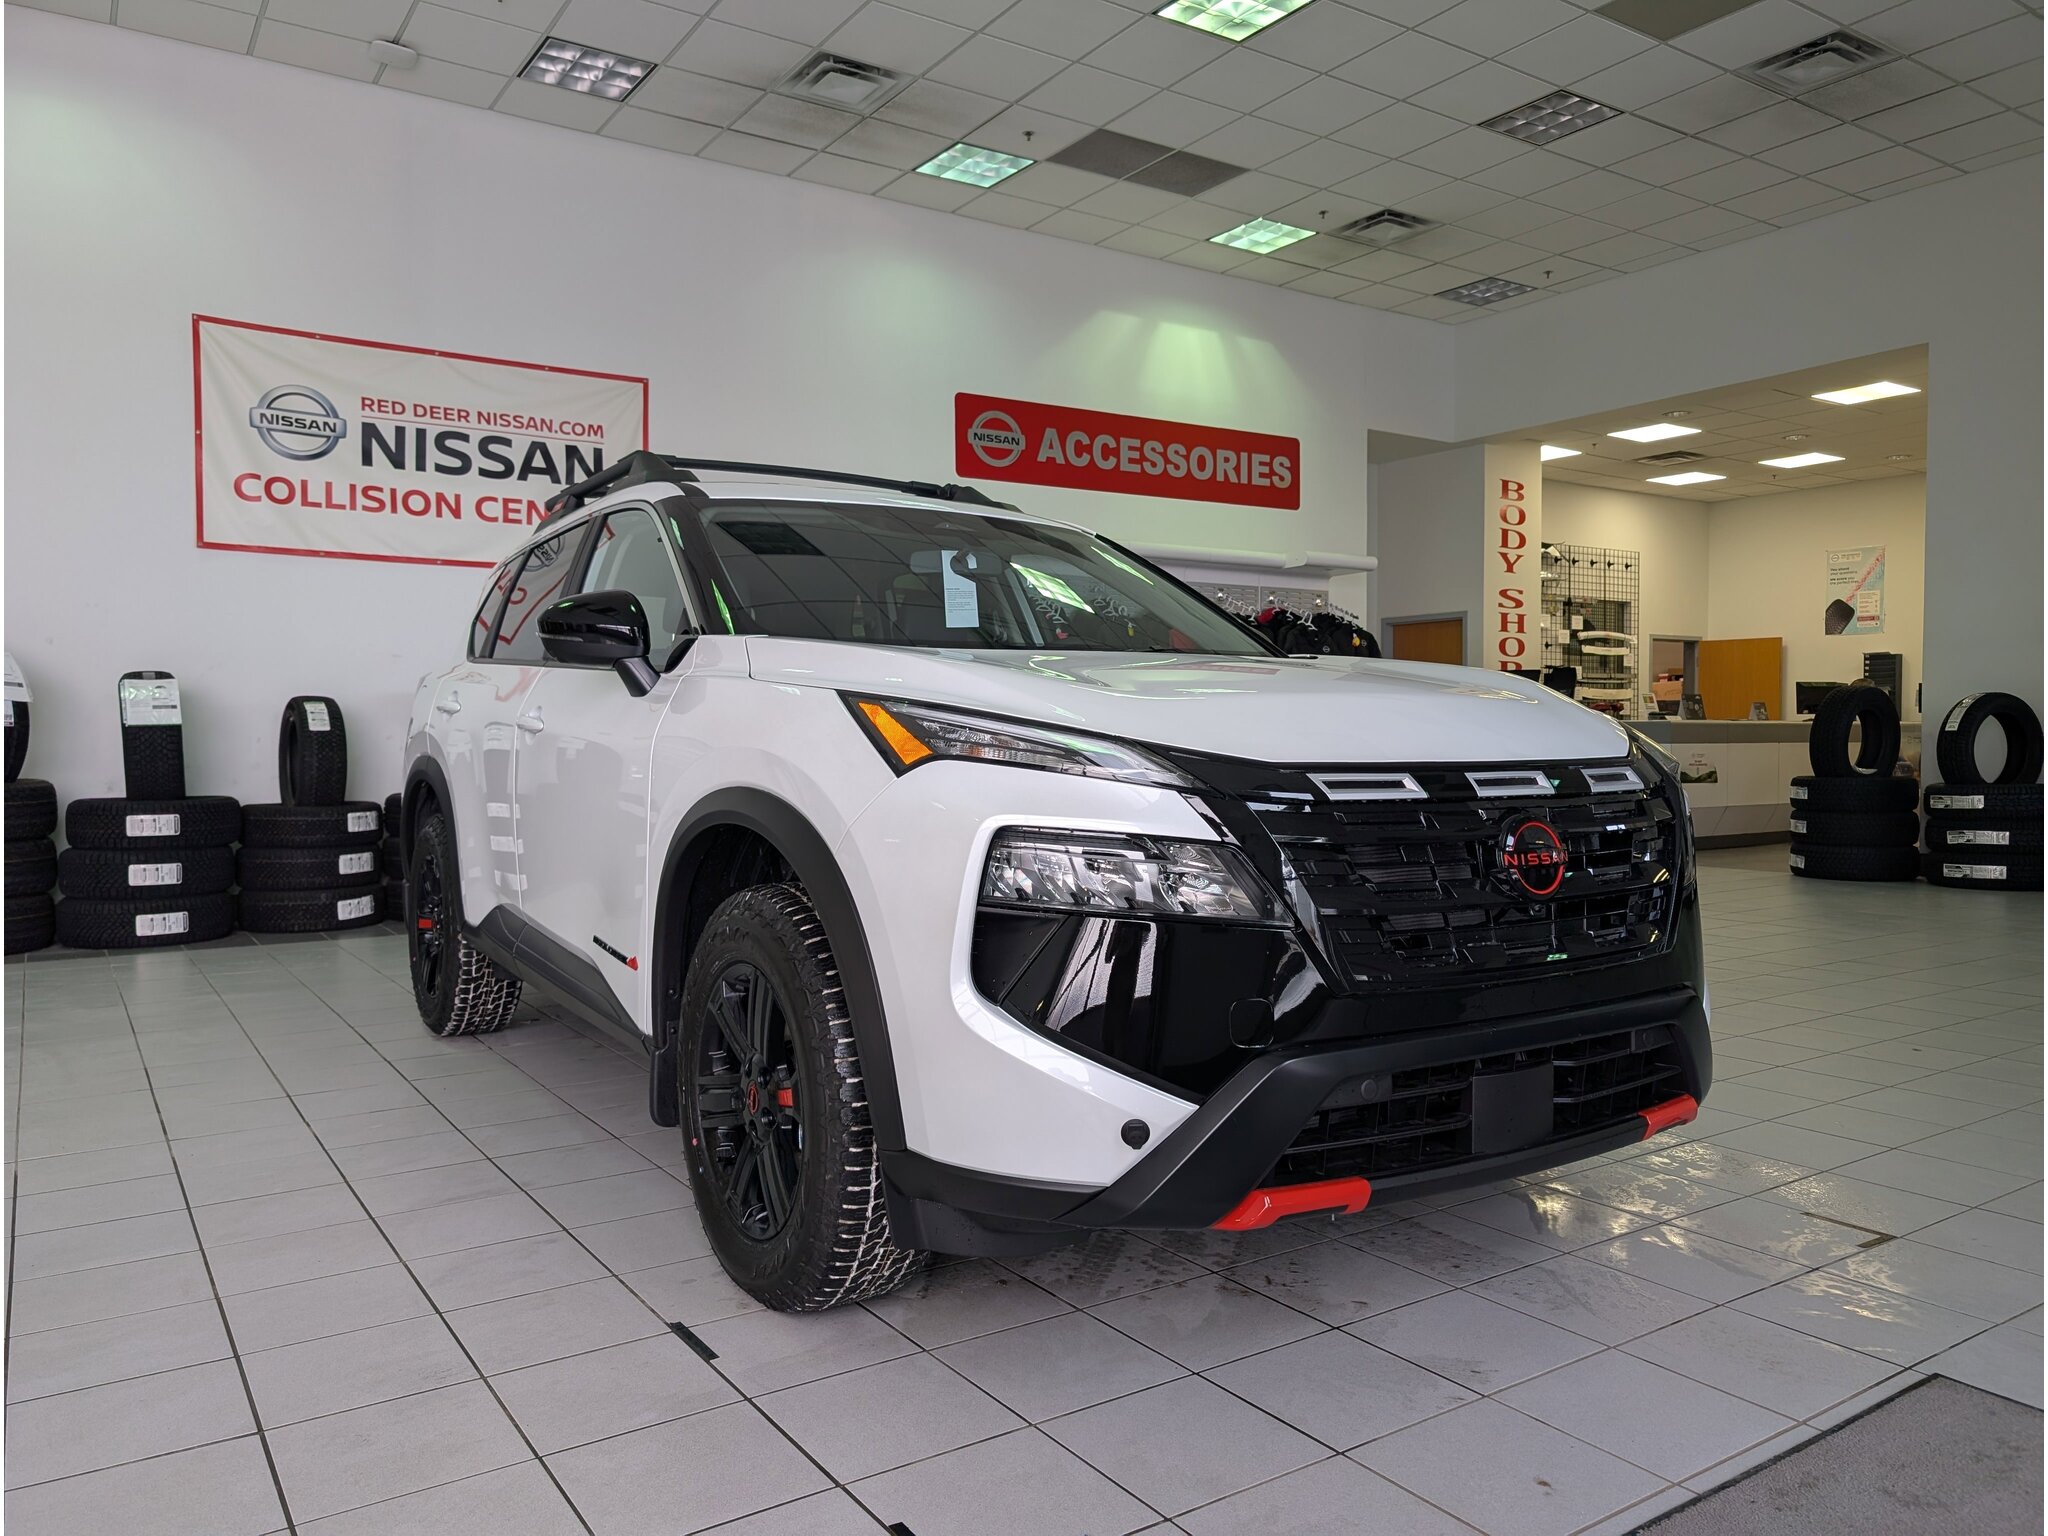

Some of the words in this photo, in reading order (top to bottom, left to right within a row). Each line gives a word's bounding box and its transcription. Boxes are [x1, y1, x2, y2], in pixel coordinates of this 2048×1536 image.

[259, 411, 338, 434] NISSAN
[360, 396, 406, 416] RED
[413, 402, 471, 424] DEER
[476, 410, 605, 439] NISSAN.COM
[972, 431, 1021, 447] NISSAN
[361, 421, 604, 485] NISSAN
[1036, 427, 1293, 489] ACCESSORIES
[233, 472, 462, 520] COLLISION
[474, 496, 551, 526] CEN
[1497, 478, 1527, 574] BODY
[1503, 850, 1569, 868] NISSAN
